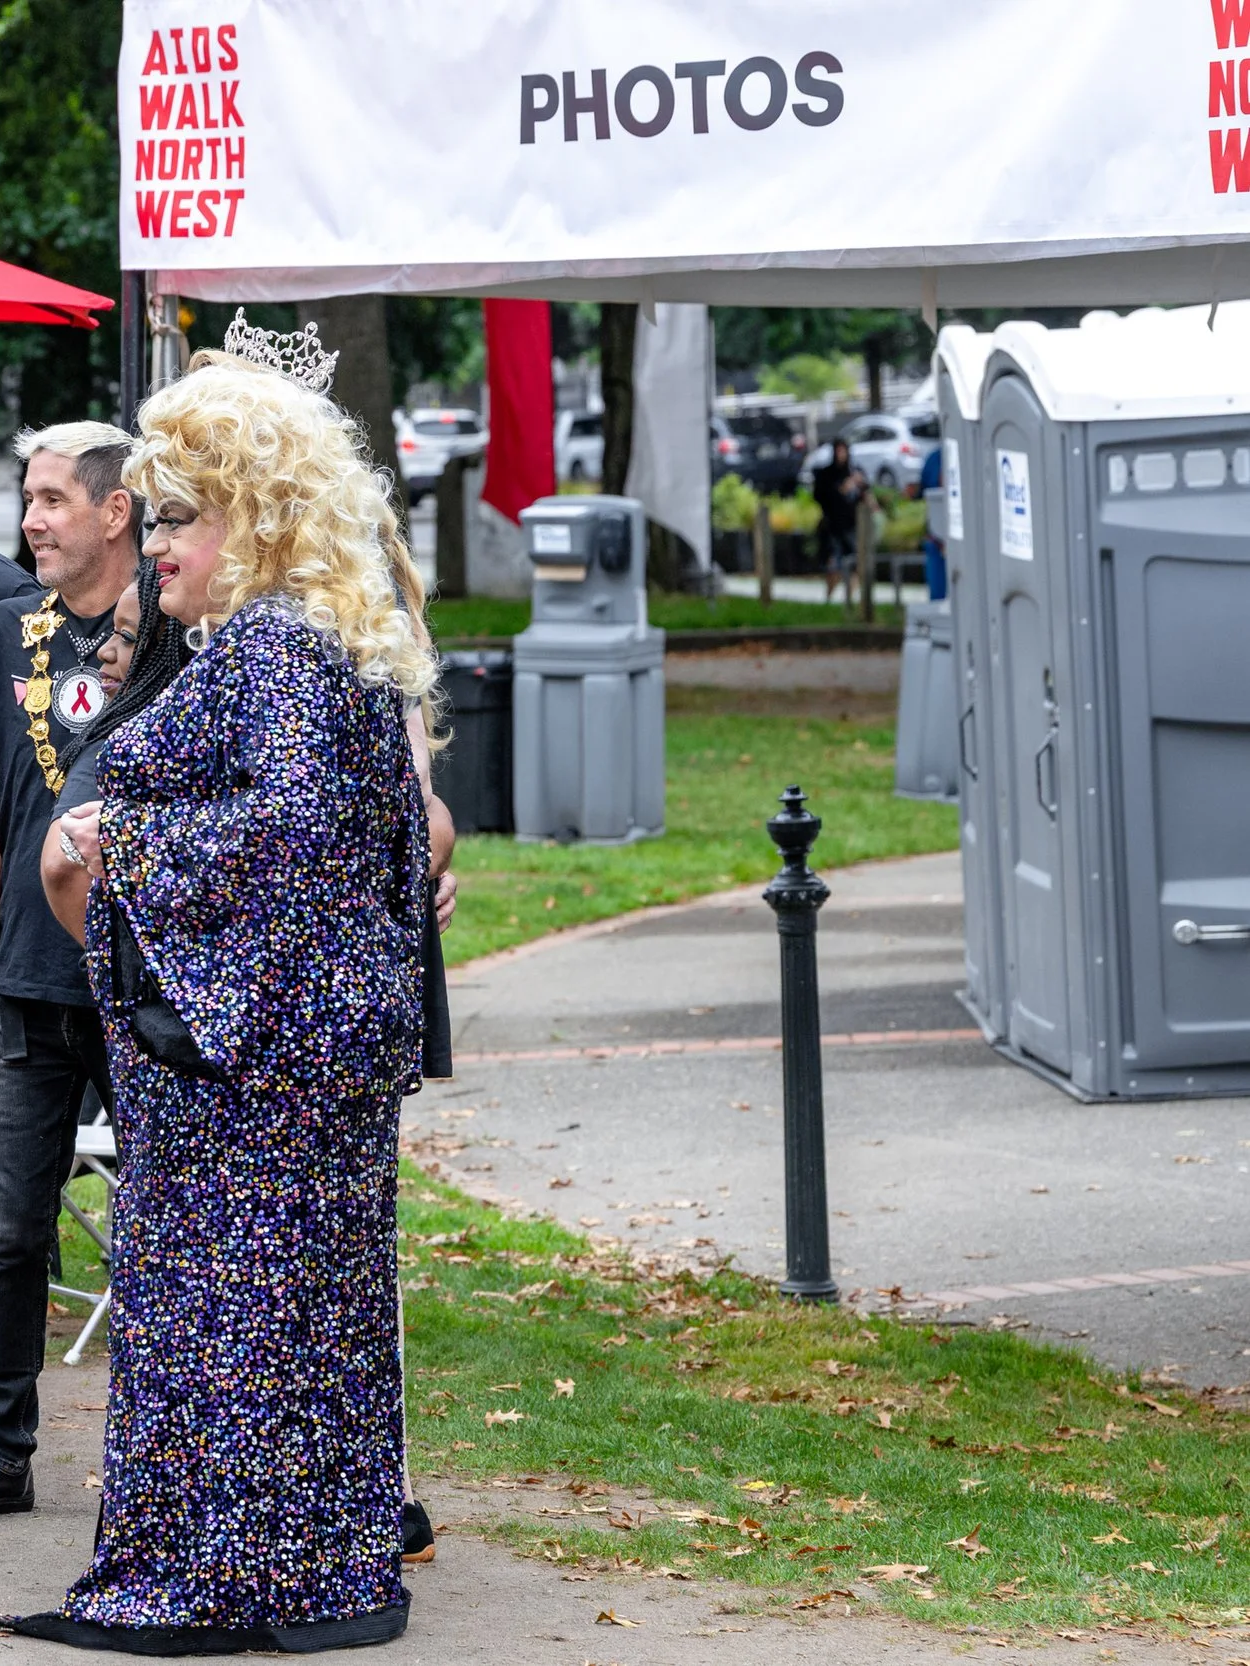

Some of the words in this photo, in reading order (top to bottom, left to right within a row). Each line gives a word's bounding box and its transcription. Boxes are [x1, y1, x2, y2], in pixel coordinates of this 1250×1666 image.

[141, 24, 239, 76] AIDS
[139, 80, 245, 131] WALK
[519, 50, 845, 145] PHOTOS
[135, 136, 245, 181] NORTH
[135, 188, 245, 239] WEST
